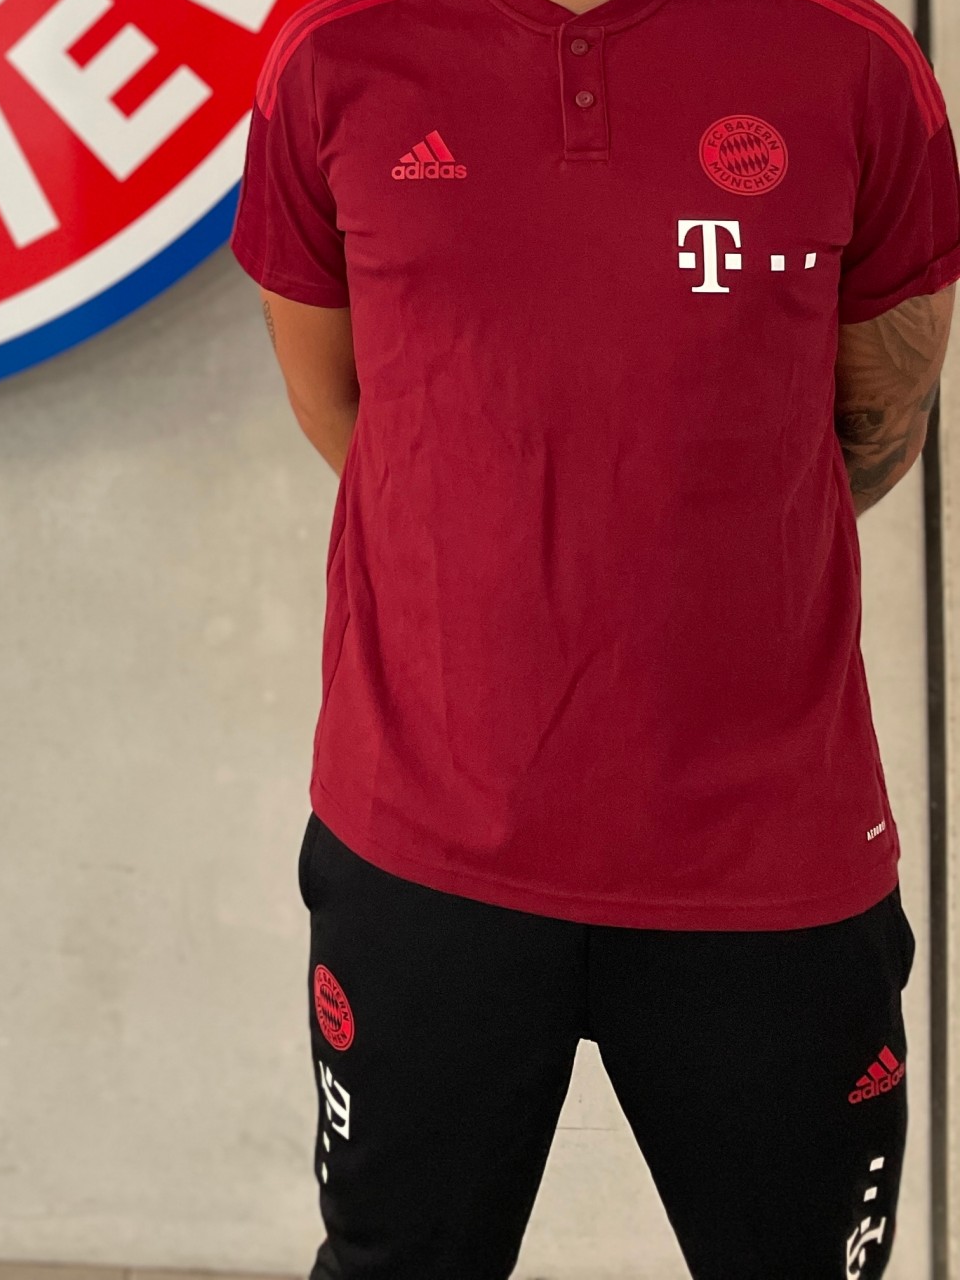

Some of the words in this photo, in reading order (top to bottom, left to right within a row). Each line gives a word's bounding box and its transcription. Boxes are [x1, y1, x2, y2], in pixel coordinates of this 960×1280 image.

[708, 131, 723, 148] FC
[724, 121, 780, 150] BAYERN
[391, 161, 467, 180] adidas
